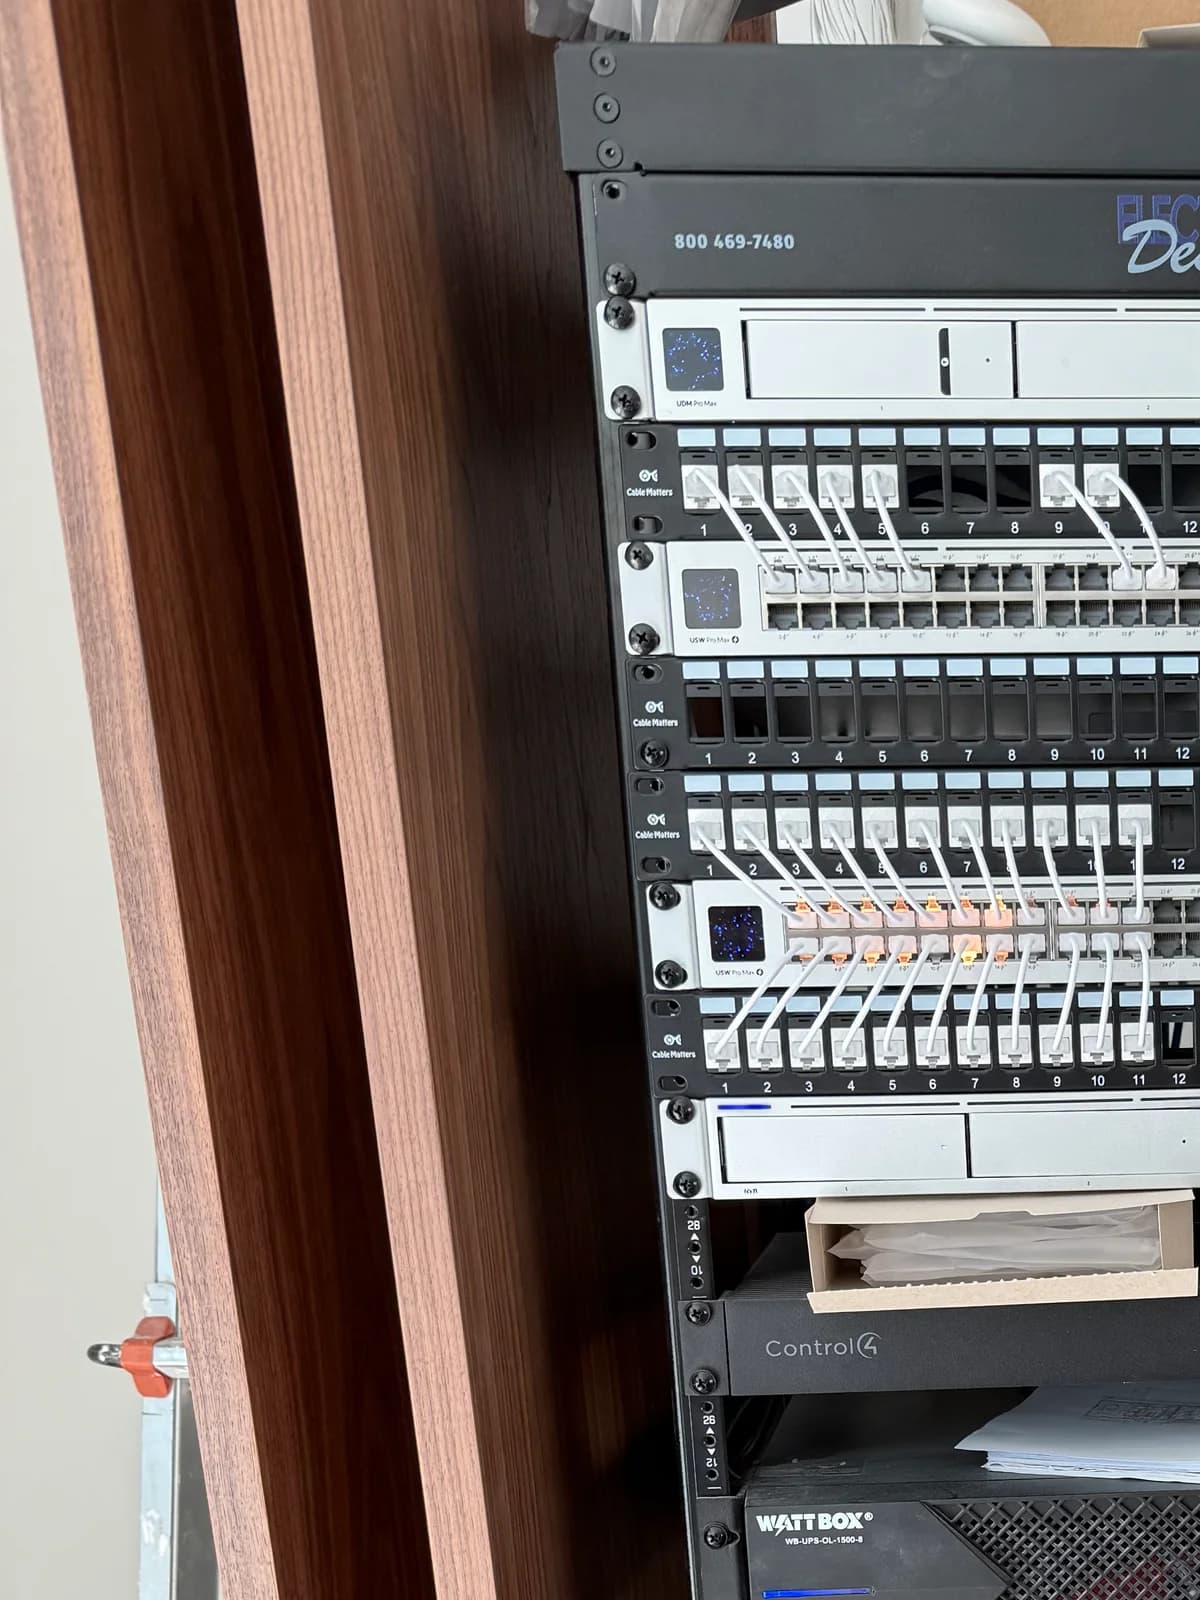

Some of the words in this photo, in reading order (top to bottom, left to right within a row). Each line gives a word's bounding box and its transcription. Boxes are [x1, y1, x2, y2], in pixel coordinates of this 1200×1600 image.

[674, 233, 708, 249] 800
[713, 233, 795, 249] 469-7480
[626, 487, 646, 497] Cable
[646, 487, 674, 497] Matters
[700, 523, 707, 537] 1
[788, 522, 798, 536] 3
[833, 522, 842, 536] 4
[878, 523, 887, 535] 5
[920, 521, 930, 535] 6
[966, 521, 975, 535] 7
[1010, 521, 1020, 534] 8
[1054, 520, 1064, 534] 9
[1182, 520, 1198, 533] 12
[632, 718, 651, 727] Cable
[652, 718, 679, 727] Matters
[705, 752, 712, 765] 1
[747, 751, 757, 765] 2
[791, 751, 800, 764] 3
[835, 751, 844, 763] 4
[878, 750, 887, 763] 5
[920, 749, 929, 762] 6
[964, 749, 973, 762] 7
[1008, 748, 1017, 762] 8
[1050, 748, 1059, 761] 9
[1090, 747, 1105, 761] 10
[1133, 747, 1147, 760] 11
[1175, 746, 1190, 760] 12
[635, 830, 653, 839] Cable
[654, 830, 680, 839] Matters
[706, 864, 713, 877] 1
[749, 863, 758, 876] 2
[792, 862, 801, 876] 3
[835, 862, 844, 875] 4
[919, 860, 928, 874] 6
[963, 860, 971, 873] 7
[1171, 857, 1185, 870] 12
[652, 1050, 670, 1059] Cable
[670, 1050, 697, 1059] Matters
[722, 1082, 728, 1094] 1
[763, 1081, 772, 1093] 2
[805, 1080, 814, 1093] 3
[847, 1079, 856, 1092] 4
[888, 1079, 897, 1091] 5
[928, 1078, 937, 1090] 6
[971, 1077, 979, 1089] 7
[1012, 1076, 1021, 1089] 8
[1053, 1075, 1062, 1088] 9
[1091, 1074, 1105, 1087] 10
[1132, 1074, 1145, 1086] 11
[1172, 1073, 1187, 1085] 12
[687, 1220, 700, 1231] 28
[703, 1415, 716, 1425] 26
[785, 1536, 863, 1545] WB-UPS-OL-1500-8
